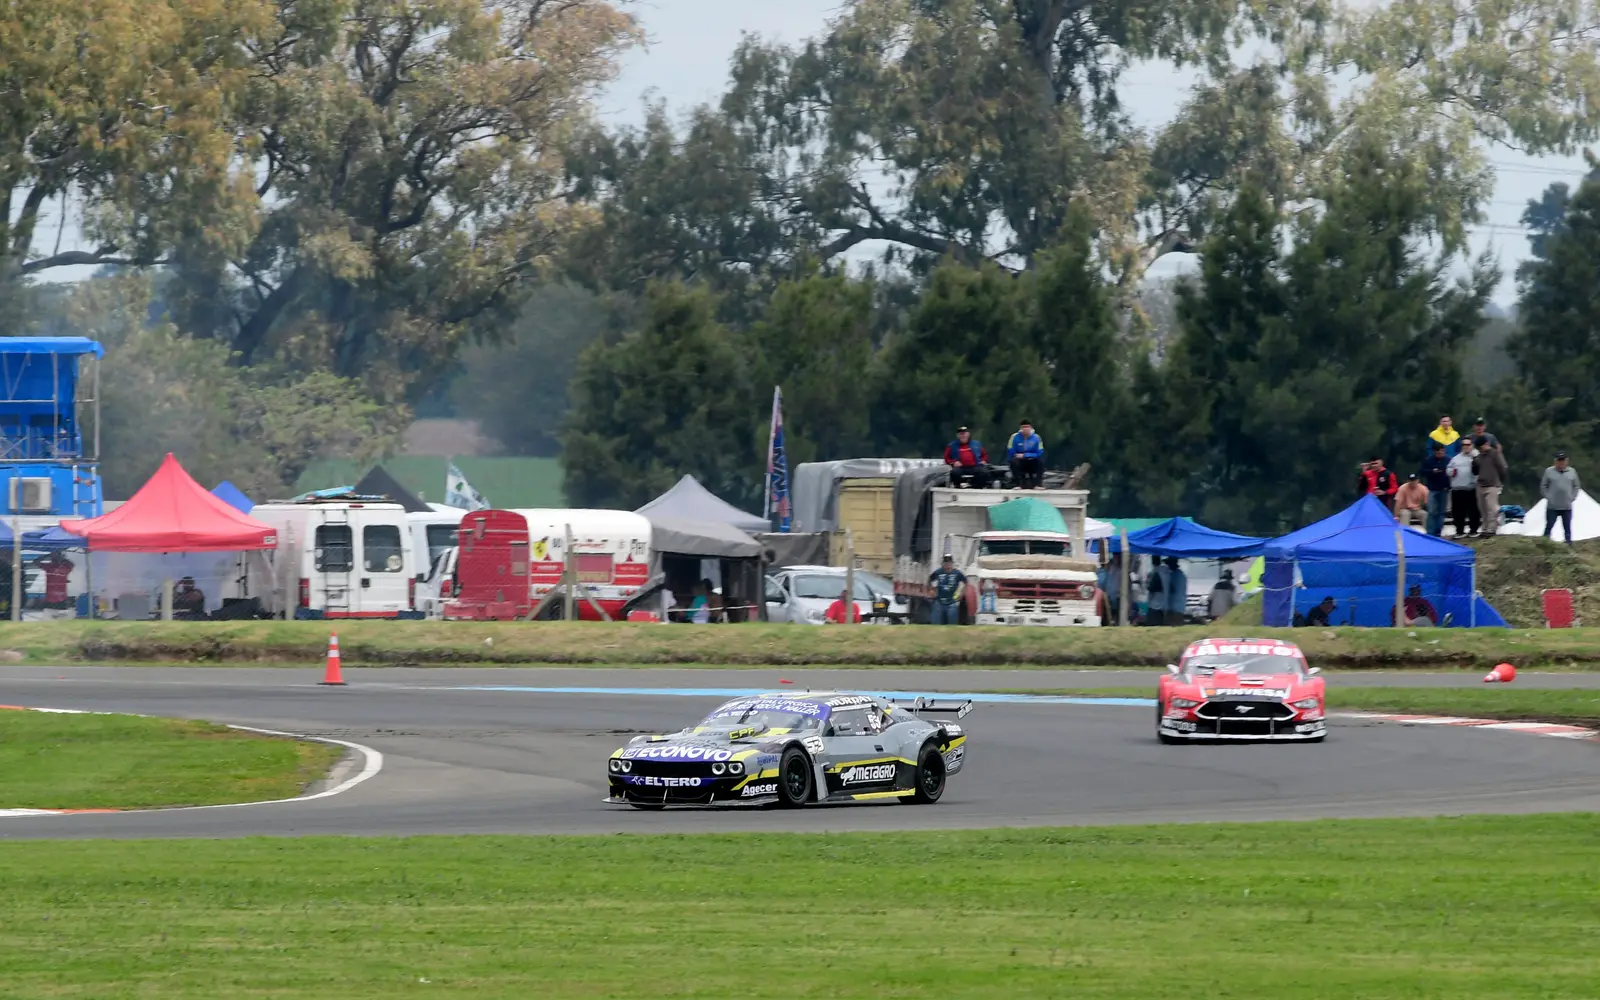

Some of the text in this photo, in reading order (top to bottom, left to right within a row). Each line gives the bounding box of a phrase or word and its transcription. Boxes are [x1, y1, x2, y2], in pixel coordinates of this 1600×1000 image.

[803, 735, 823, 754] 53
[637, 746, 732, 761] ECONOVO
[742, 783, 778, 796] Agecer
